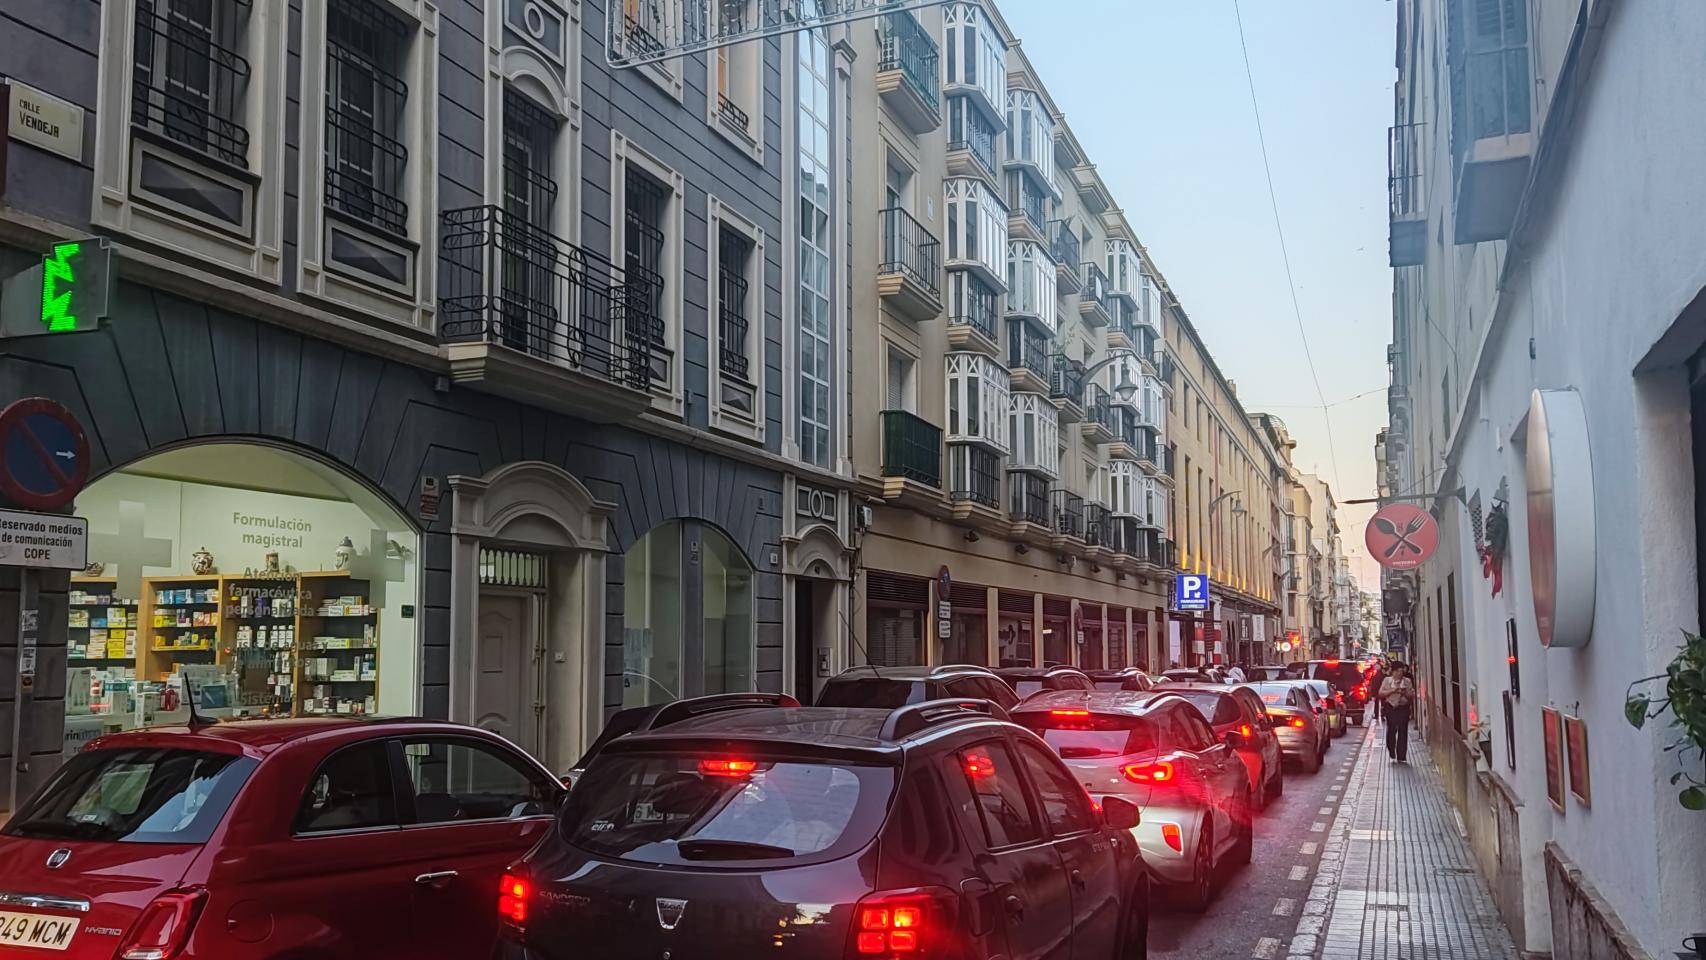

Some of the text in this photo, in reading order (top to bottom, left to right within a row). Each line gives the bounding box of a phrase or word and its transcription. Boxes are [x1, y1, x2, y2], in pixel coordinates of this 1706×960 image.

[19, 99, 40, 114] CALLE
[19, 111, 59, 138] VENDEJA
[0, 519, 83, 536] eservado medios
[233, 512, 312, 532] Formulación
[1, 531, 73, 548] de comunicación
[242, 533, 303, 548] magistral
[24, 548, 51, 560] COPE
[28, 919, 72, 946] MCM
